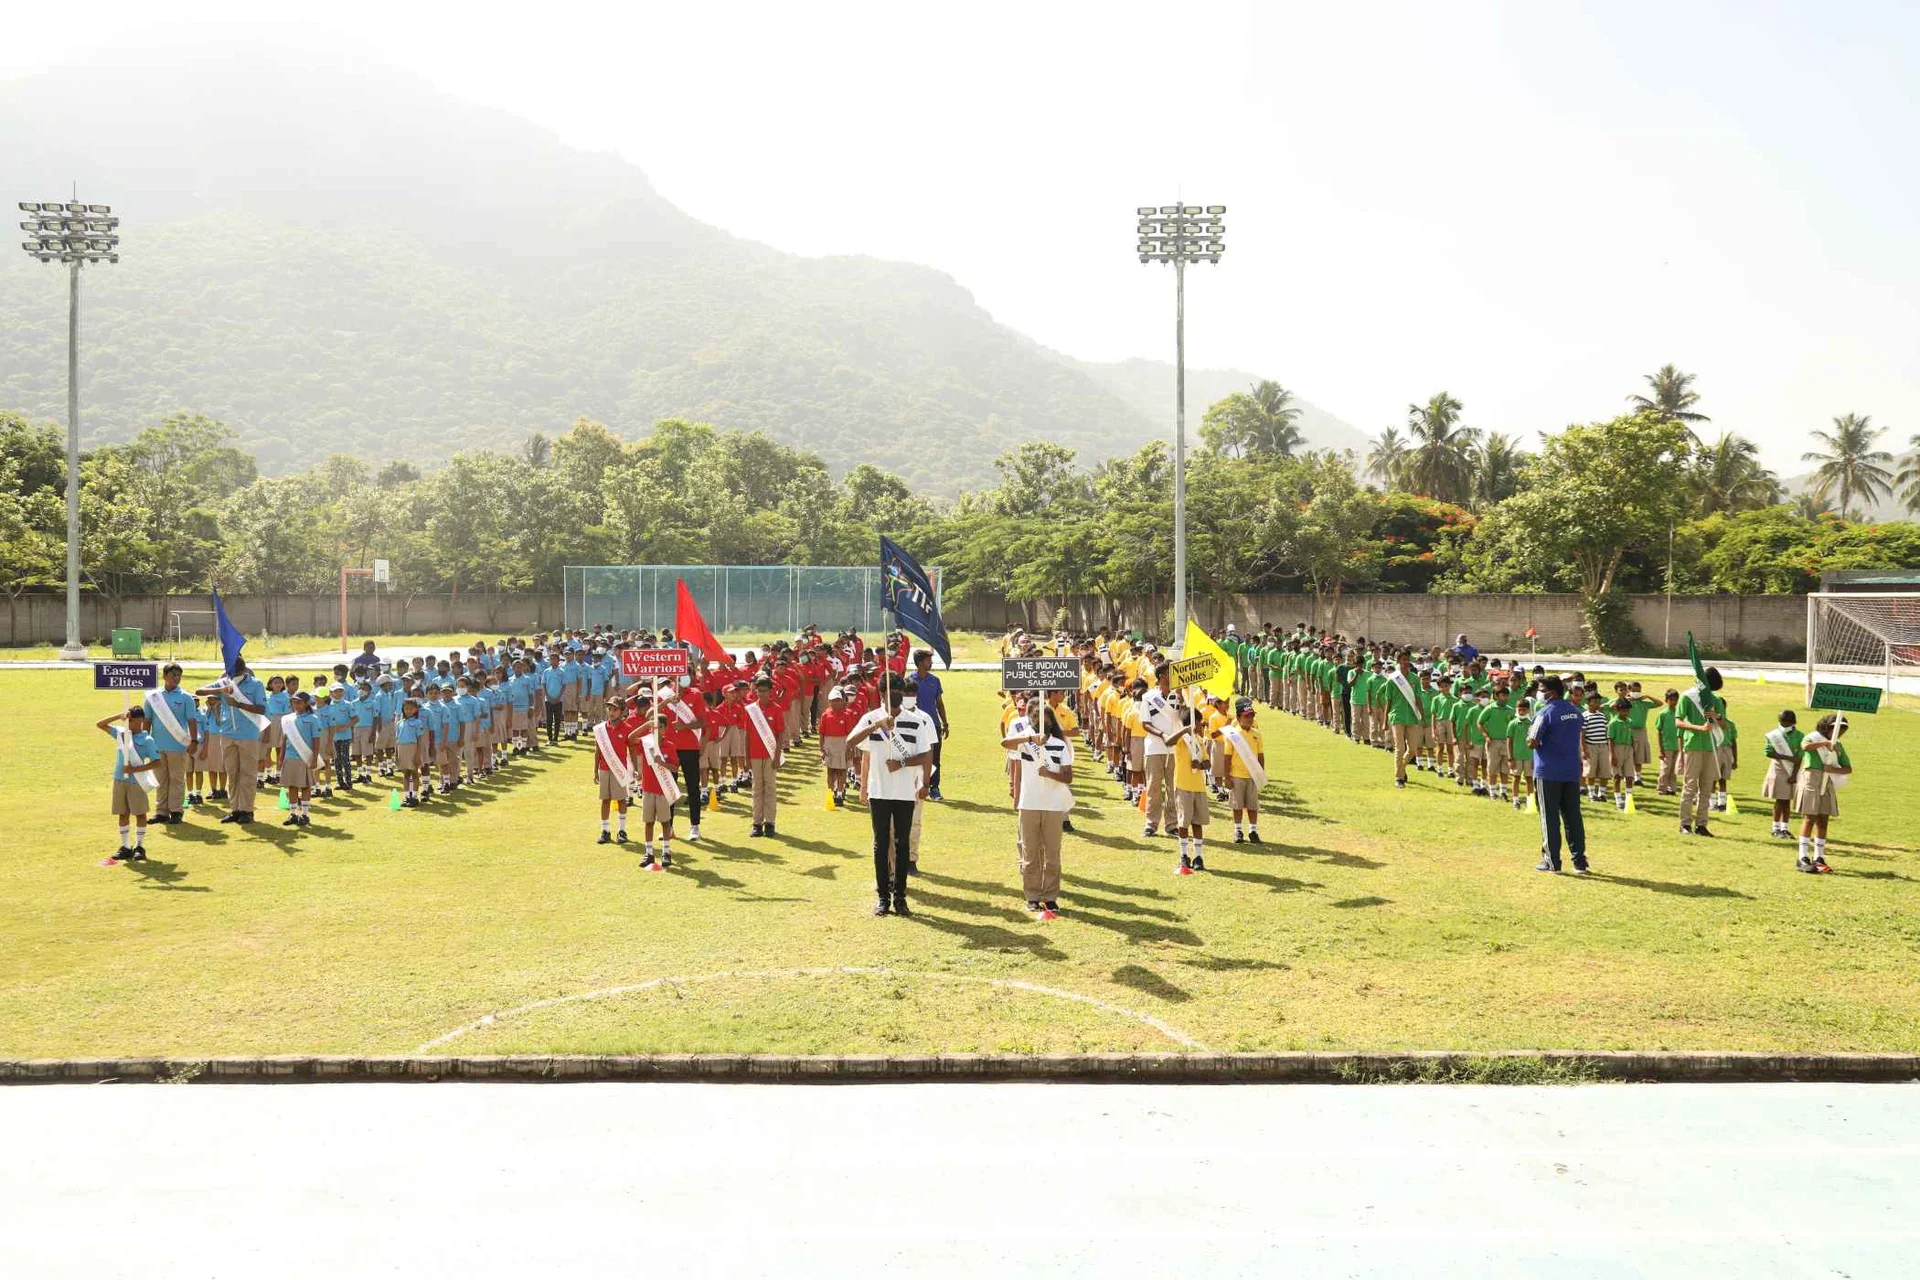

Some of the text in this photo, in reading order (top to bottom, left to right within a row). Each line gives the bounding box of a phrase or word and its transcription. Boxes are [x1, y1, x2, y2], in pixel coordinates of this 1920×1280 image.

[629, 651, 681, 662] Western
[102, 665, 151, 676] Eastern
[626, 663, 685, 674] Warriors
[1016, 661, 1068, 670] THE INDIAN
[1172, 658, 1211, 676] Northern
[1006, 670, 1078, 679] PUBLIC SCHOOL
[1178, 670, 1207, 684] Nobles
[110, 676, 144, 688] Elites
[1027, 679, 1057, 687] SALEM
[1816, 685, 1877, 700] Southern
[1814, 696, 1874, 711] Stalwarts
